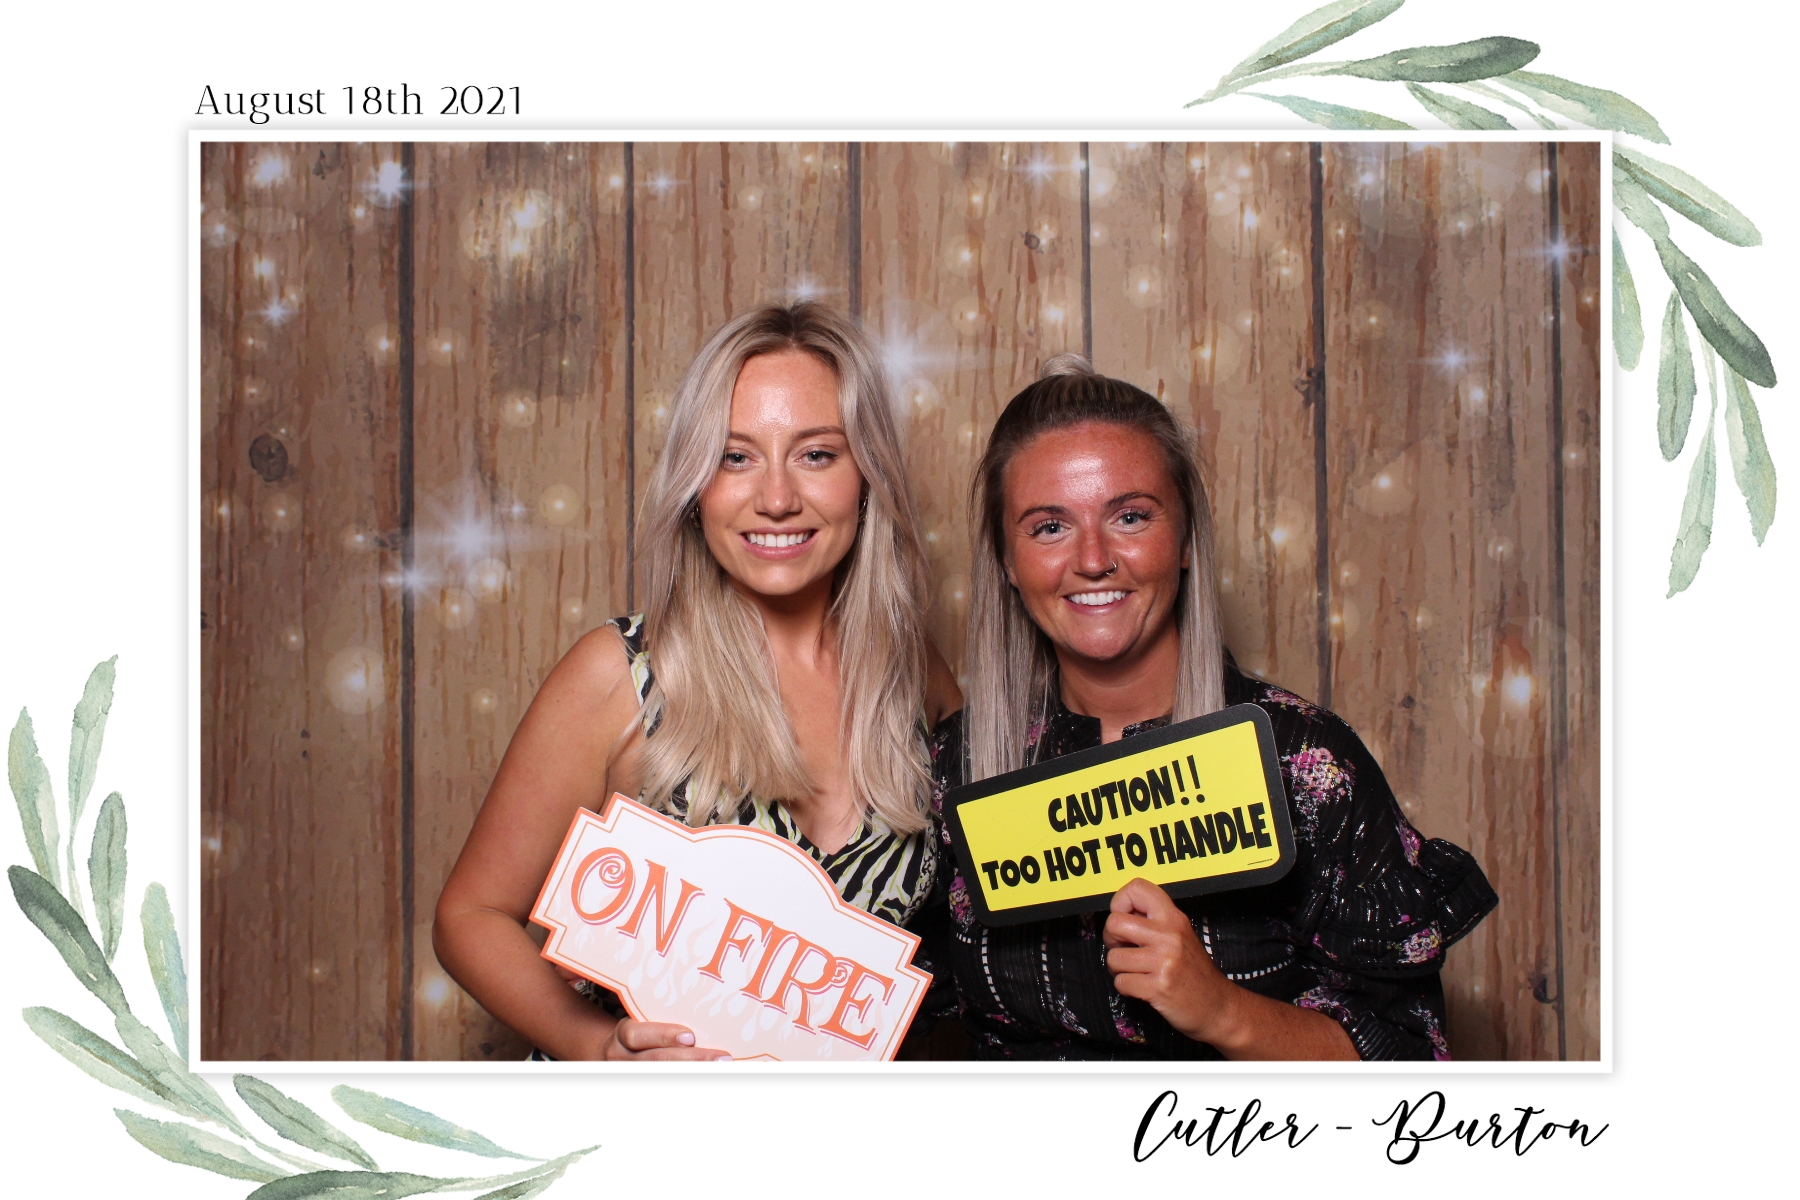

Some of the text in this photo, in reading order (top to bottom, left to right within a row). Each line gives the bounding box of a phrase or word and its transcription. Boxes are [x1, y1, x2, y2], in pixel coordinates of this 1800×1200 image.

[1047, 754, 1207, 834] CAUTION!!
[981, 801, 1273, 891] TOO HOT TO HANDLE
[570, 847, 897, 1052] ON FIRE
